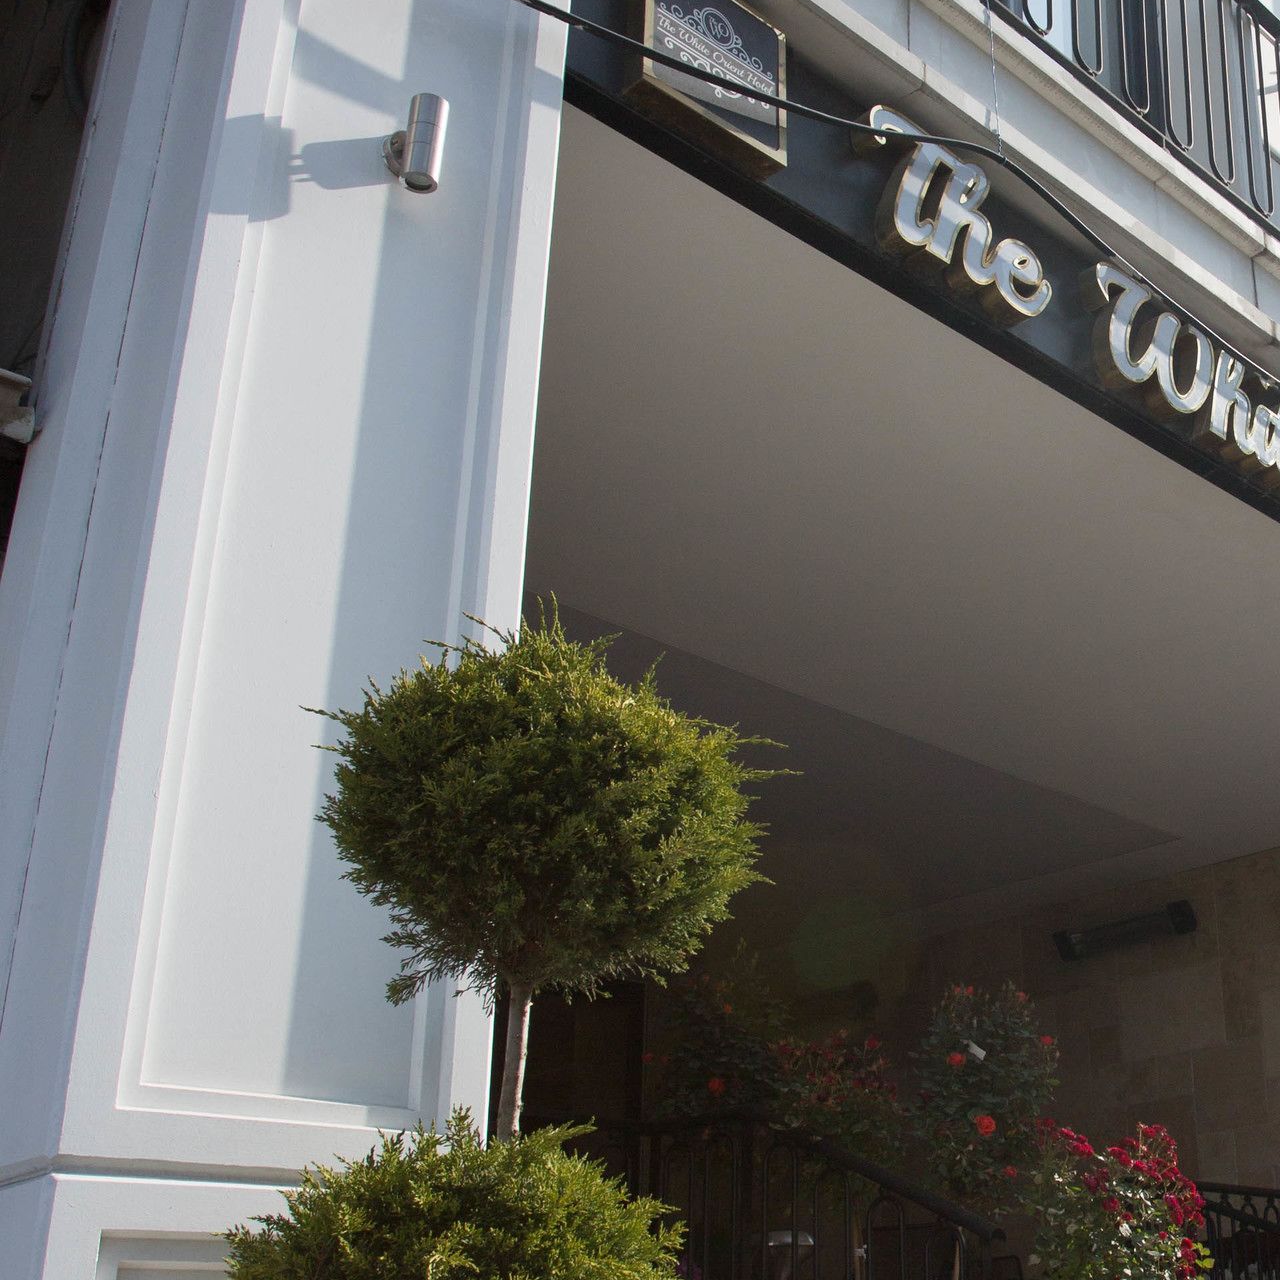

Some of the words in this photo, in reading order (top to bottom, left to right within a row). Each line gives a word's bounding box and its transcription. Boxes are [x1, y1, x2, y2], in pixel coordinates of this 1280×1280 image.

[657, 13, 676, 34] The
[679, 26, 710, 57] White
[712, 51, 747, 79] Orient
[747, 70, 773, 96] Hotel
[869, 104, 1052, 317] The
